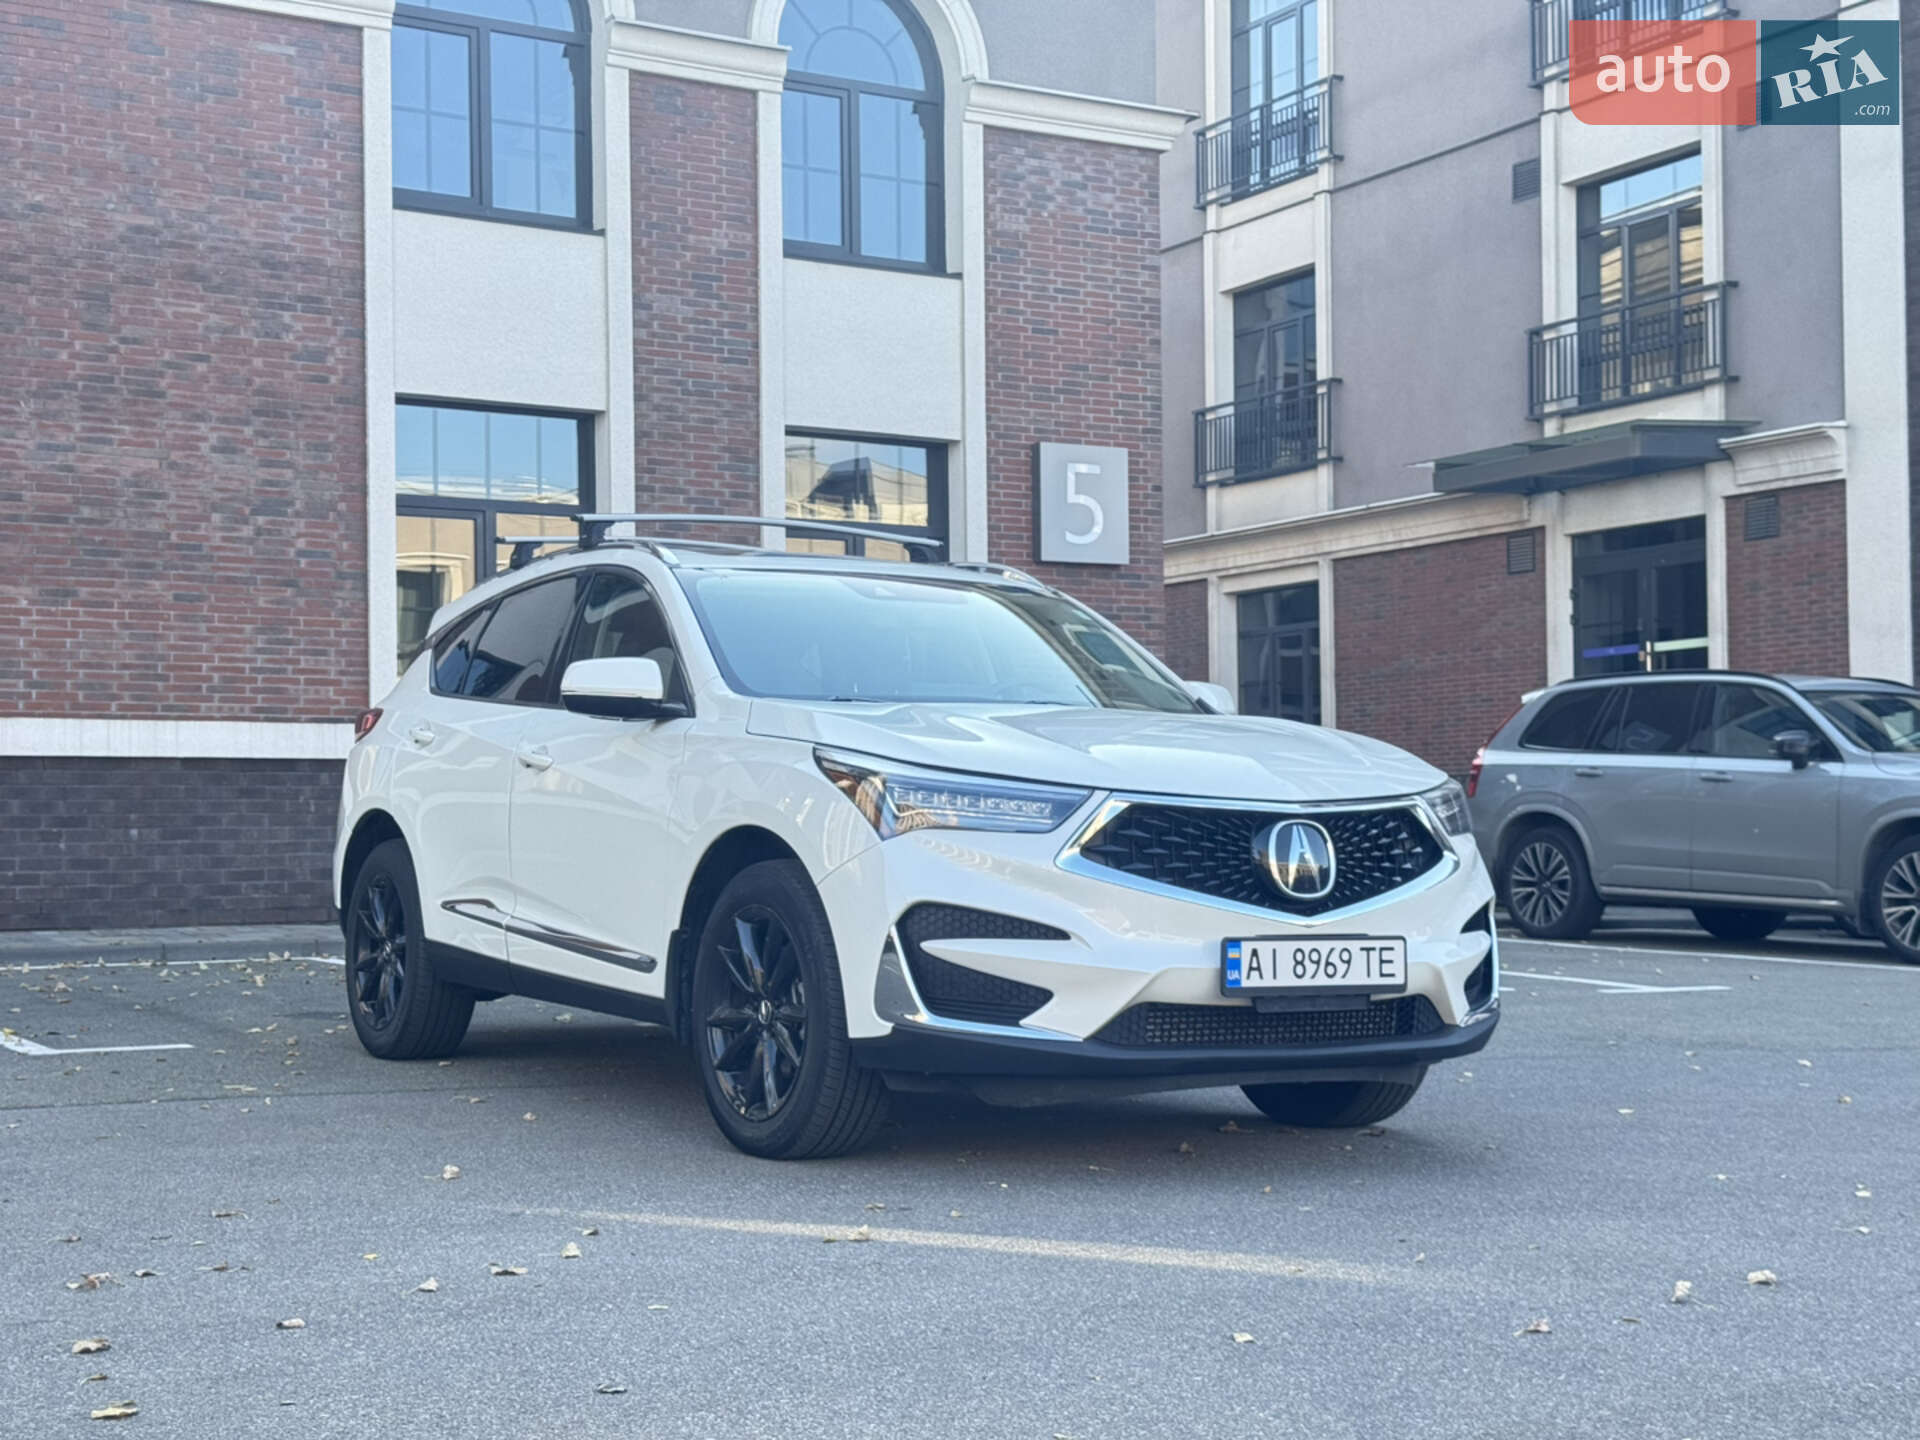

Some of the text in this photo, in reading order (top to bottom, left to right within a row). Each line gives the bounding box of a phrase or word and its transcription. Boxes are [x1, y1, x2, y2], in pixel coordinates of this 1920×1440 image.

[1065, 463, 1104, 545] 5
[1227, 969, 1241, 981] UA
[1246, 946, 1396, 980] AI 8969 TE
